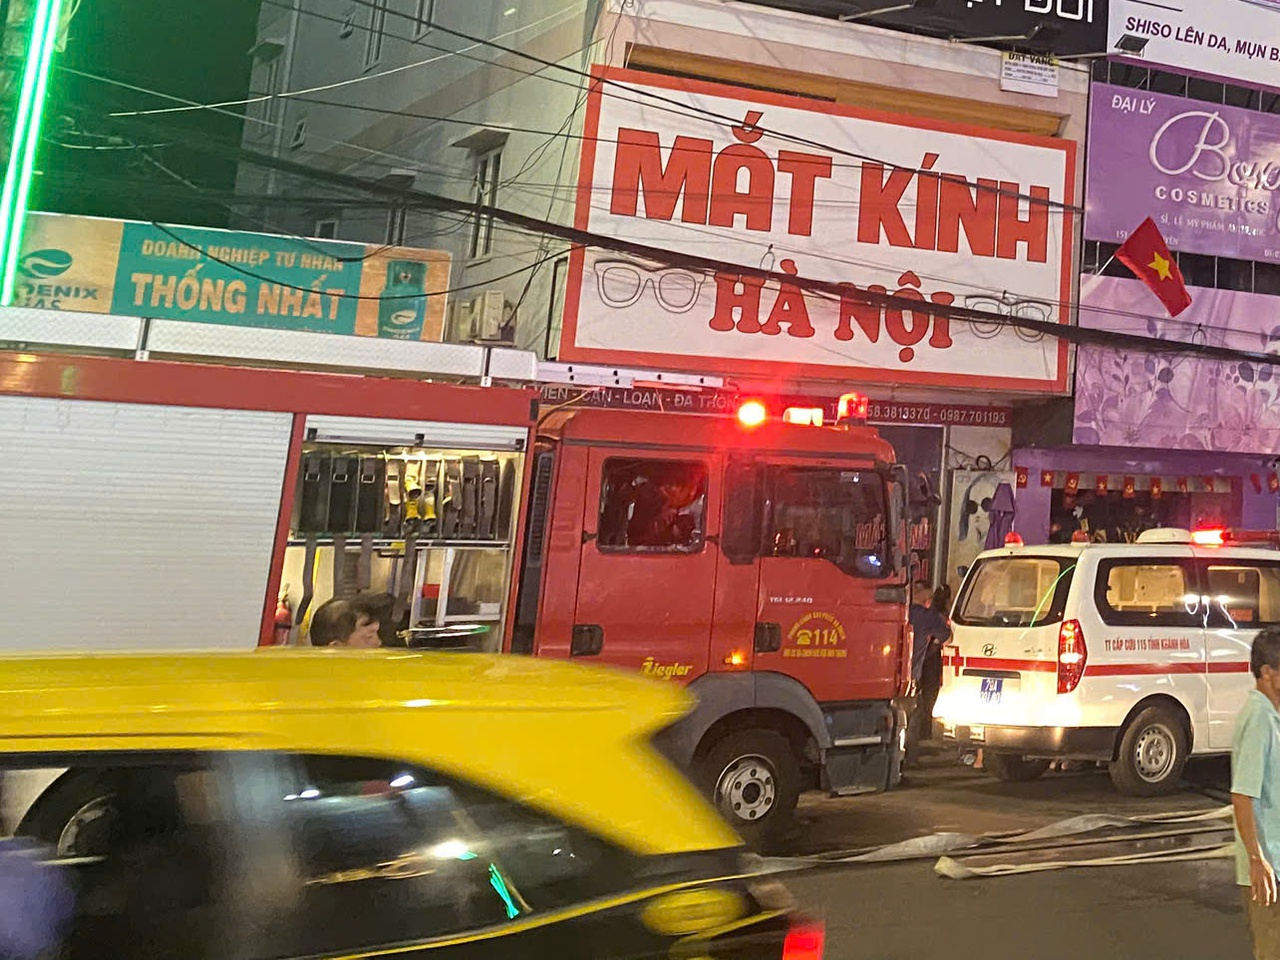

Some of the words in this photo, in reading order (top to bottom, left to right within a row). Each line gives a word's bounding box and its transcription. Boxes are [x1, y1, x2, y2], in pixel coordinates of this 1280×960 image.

[1125, 16, 1172, 39] SHISO
[1175, 25, 1205, 46] LÊN
[1207, 34, 1232, 54] DA,
[1234, 39, 1267, 60] MỤN
[1111, 94, 1136, 116] ĐẠI
[1139, 97, 1157, 113] LÝ
[609, 110, 834, 237] MẮT
[856, 152, 1051, 263] KÍNH
[1154, 185, 1270, 215] COSMETICS
[141, 239, 200, 261] DOANH
[206, 244, 271, 268] NGHIỆP
[130, 261, 248, 315] THỐNG
[257, 273, 346, 321] NHẤT
[708, 258, 817, 339] HÀ
[833, 270, 957, 363] NỘI
[674, 394, 694, 407] ĐA
[813, 629, 838, 646] 114
[1137, 639, 1147, 651] 115
